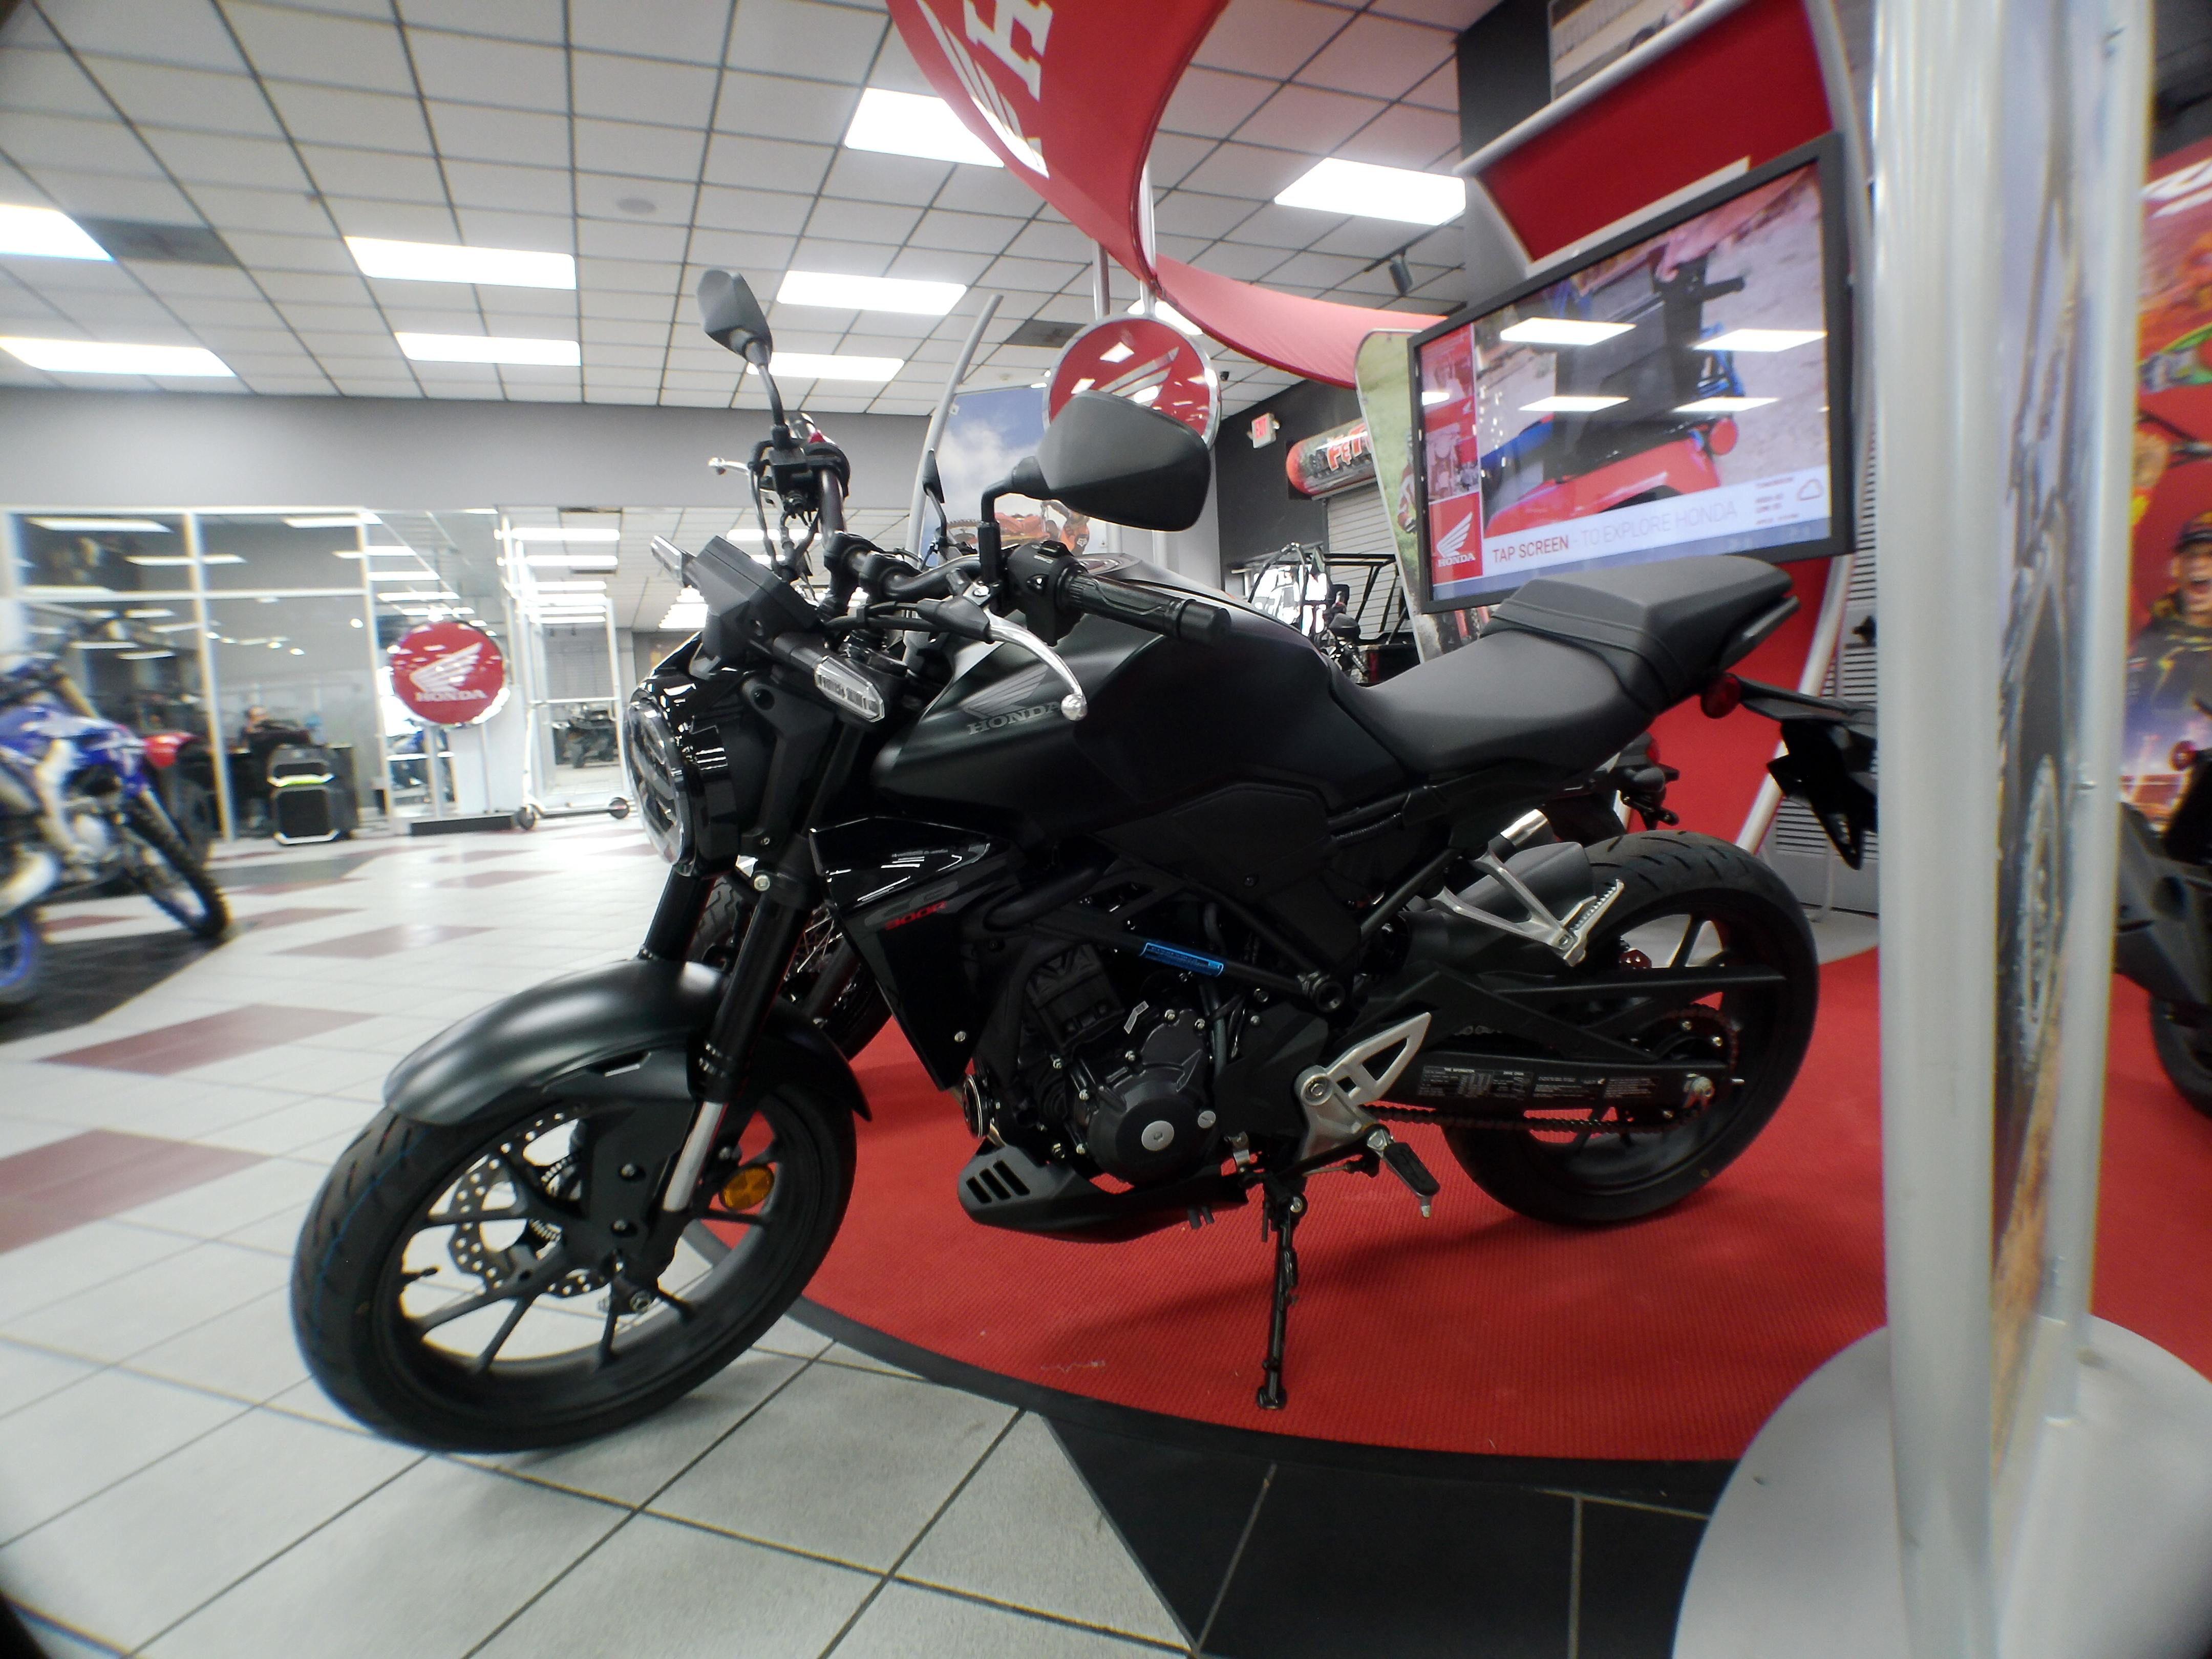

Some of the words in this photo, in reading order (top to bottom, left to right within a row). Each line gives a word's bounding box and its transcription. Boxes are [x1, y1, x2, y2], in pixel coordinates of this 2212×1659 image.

[1492, 546, 1516, 563] TAP
[1519, 535, 1569, 558] SCREEN
[1580, 528, 1600, 545] TO
[1603, 513, 1672, 543] EXPLORE
[1675, 501, 1737, 527] HONDA
[1438, 553, 1476, 567] HONDA
[415, 689, 487, 702] HONDA
[967, 701, 1061, 735] HONDA
